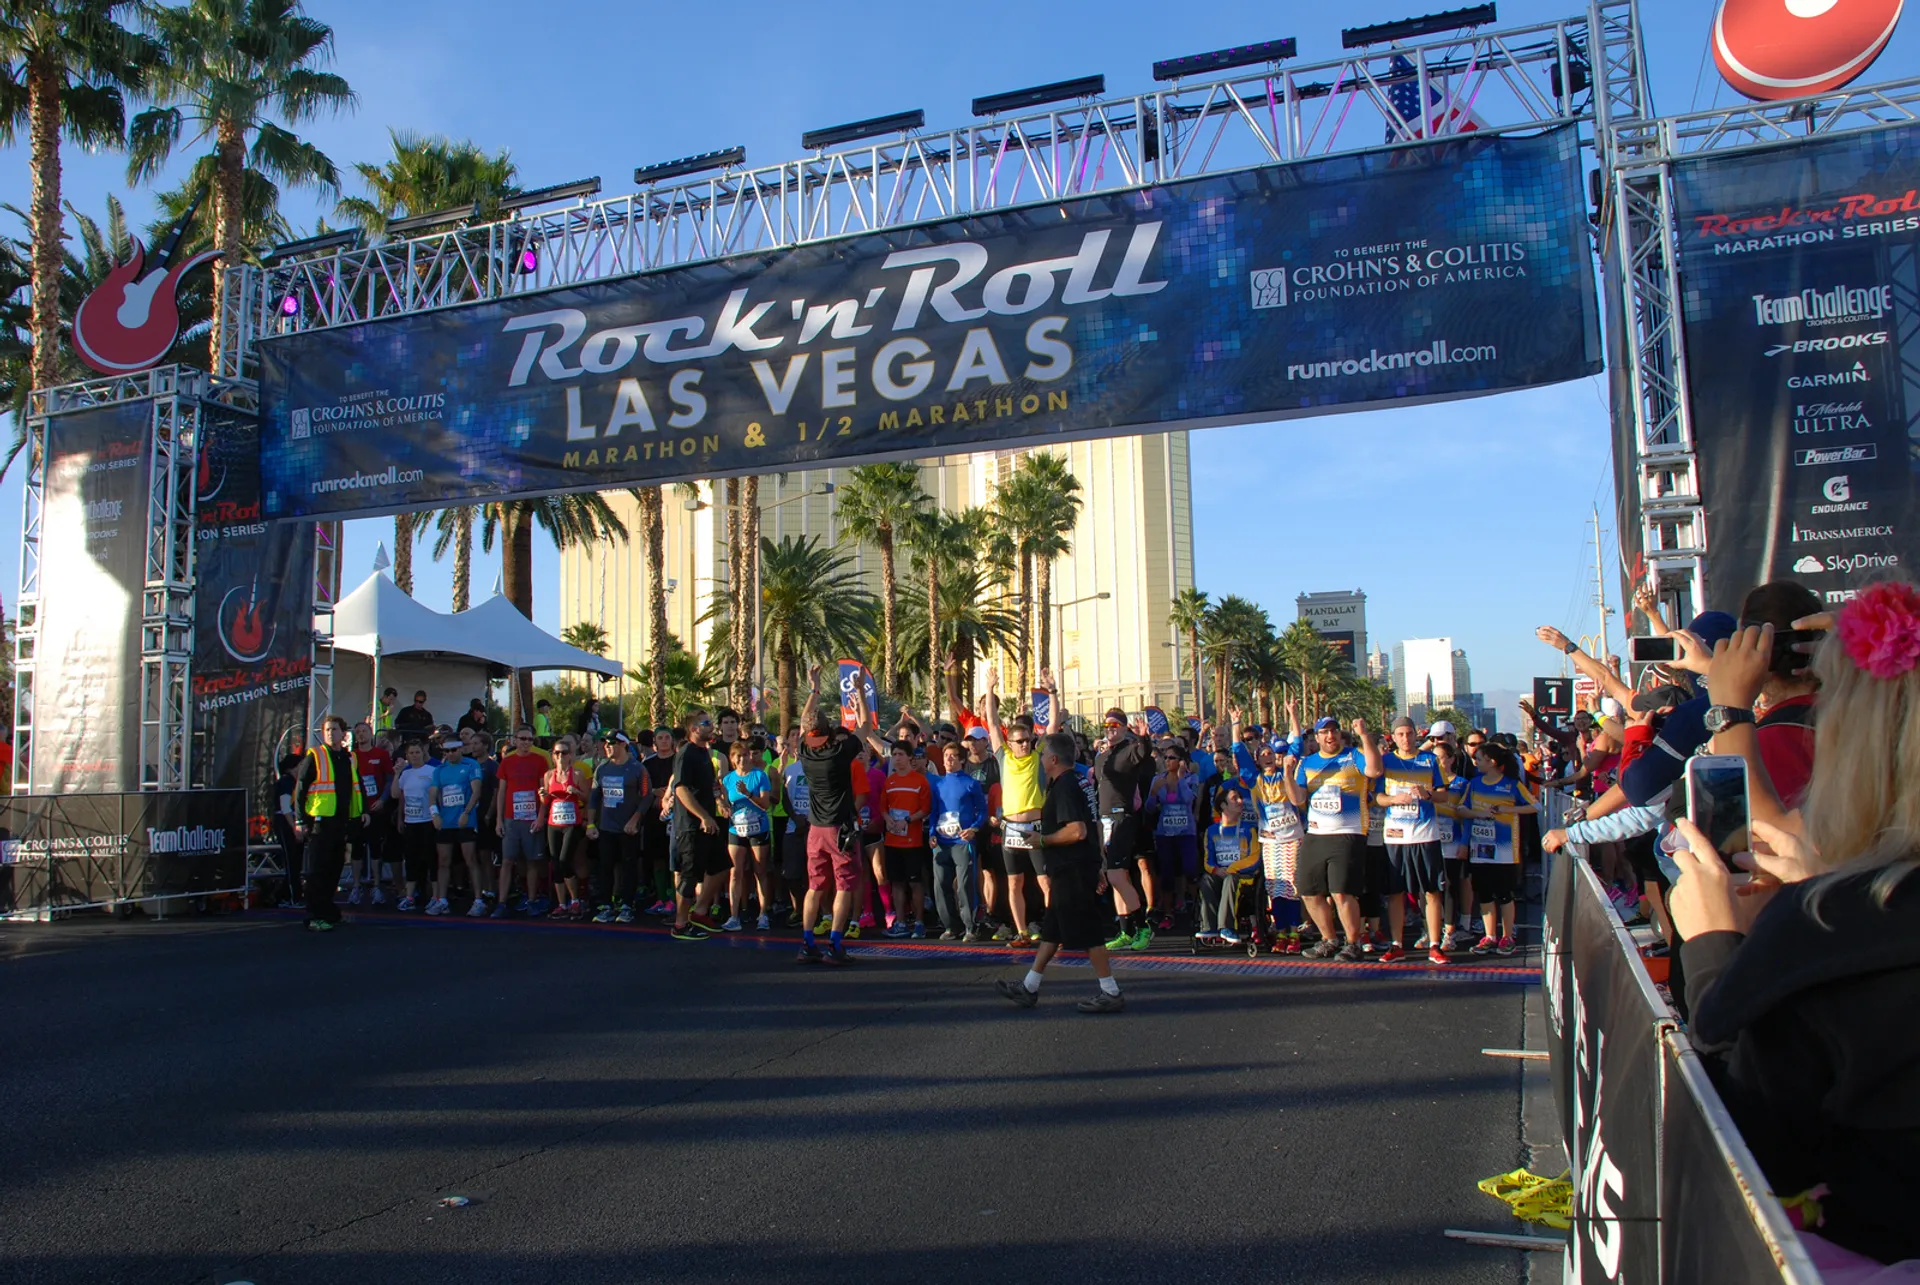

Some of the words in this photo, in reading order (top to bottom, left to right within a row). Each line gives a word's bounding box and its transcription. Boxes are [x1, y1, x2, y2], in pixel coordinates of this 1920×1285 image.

[1713, 228, 1835, 256] MARATHON
[1841, 216, 1920, 239] SERIES
[1334, 249, 1349, 258] TO
[1353, 243, 1401, 256] BENEFIT
[1405, 239, 1428, 249] THE
[1292, 254, 1400, 287] CROHN'S
[1405, 254, 1421, 274] &
[1426, 242, 1526, 270] COLITIS
[1293, 277, 1411, 303] FOUNDATION
[1417, 273, 1439, 287] OF
[1444, 265, 1527, 284] AMERICA
[1792, 331, 1889, 353] BROOKS
[1287, 340, 1497, 380] runrocknroll.com
[564, 368, 708, 443] LAS
[749, 316, 1075, 417] VEGAS
[1787, 369, 1871, 389] GARMIN
[350, 391, 374, 402] BENEFIT
[311, 401, 374, 423] CROHN'S
[376, 400, 386, 415] &
[386, 393, 446, 413] COLITIS
[312, 418, 380, 436] FOUNDATION
[382, 416, 395, 427] OF
[397, 410, 443, 425] AMERICA
[562, 434, 720, 470] MARATHON
[743, 423, 767, 448] &
[798, 416, 853, 441] 1/2
[877, 390, 1069, 431] MARATHON
[1793, 413, 1872, 434] ULTRA
[107, 458, 138, 470] SERIES
[1804, 447, 1867, 464] PowerBar
[311, 466, 424, 494] runrocknroll.com
[1811, 501, 1869, 515] ENDURANCE
[222, 523, 266, 539] SERIES
[1826, 552, 1899, 574] SkyDrive
[1305, 605, 1356, 617] MANDALAY
[1322, 618, 1340, 628] BAY
[200, 686, 269, 712] MARATHON
[1547, 686, 1557, 705] 1
[1312, 801, 1340, 810] 41453
